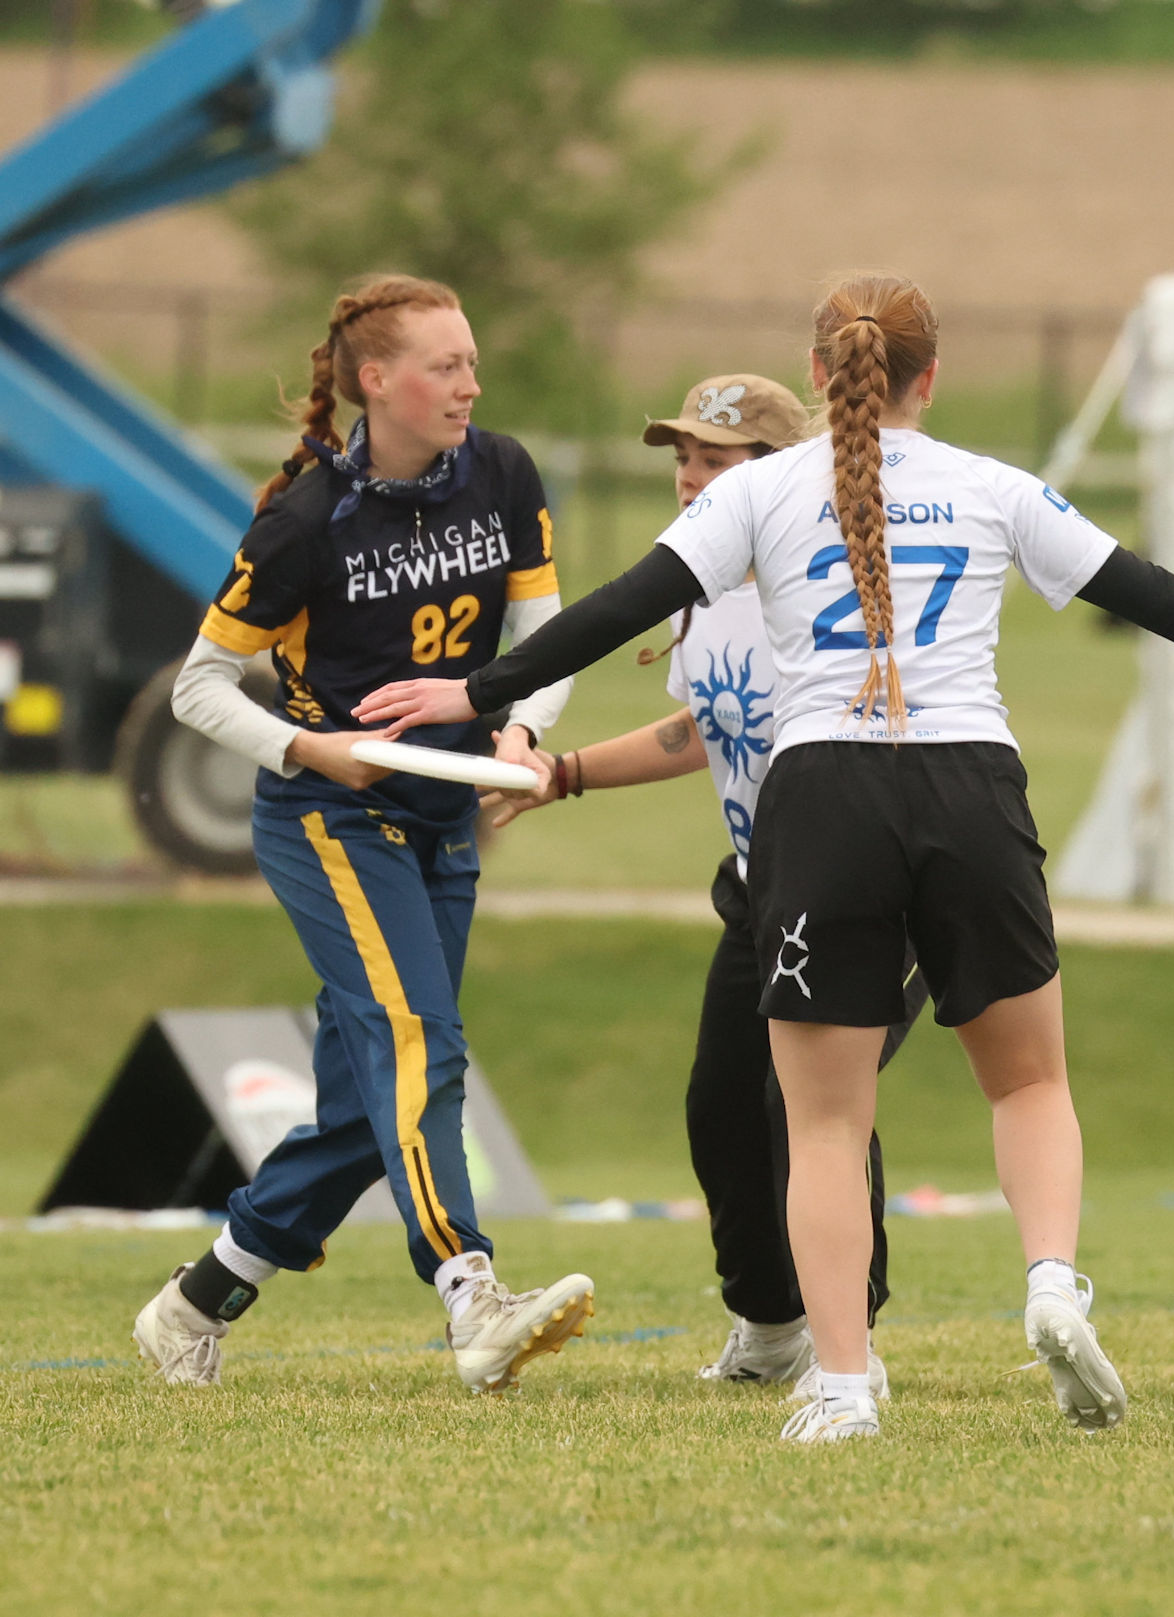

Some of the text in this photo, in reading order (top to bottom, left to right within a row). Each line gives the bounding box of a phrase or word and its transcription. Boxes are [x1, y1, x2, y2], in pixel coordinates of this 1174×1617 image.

[345, 511, 503, 574] MICHIGAN
[816, 501, 954, 524] ASON
[411, 594, 481, 665] 82
[806, 544, 970, 651] 27
